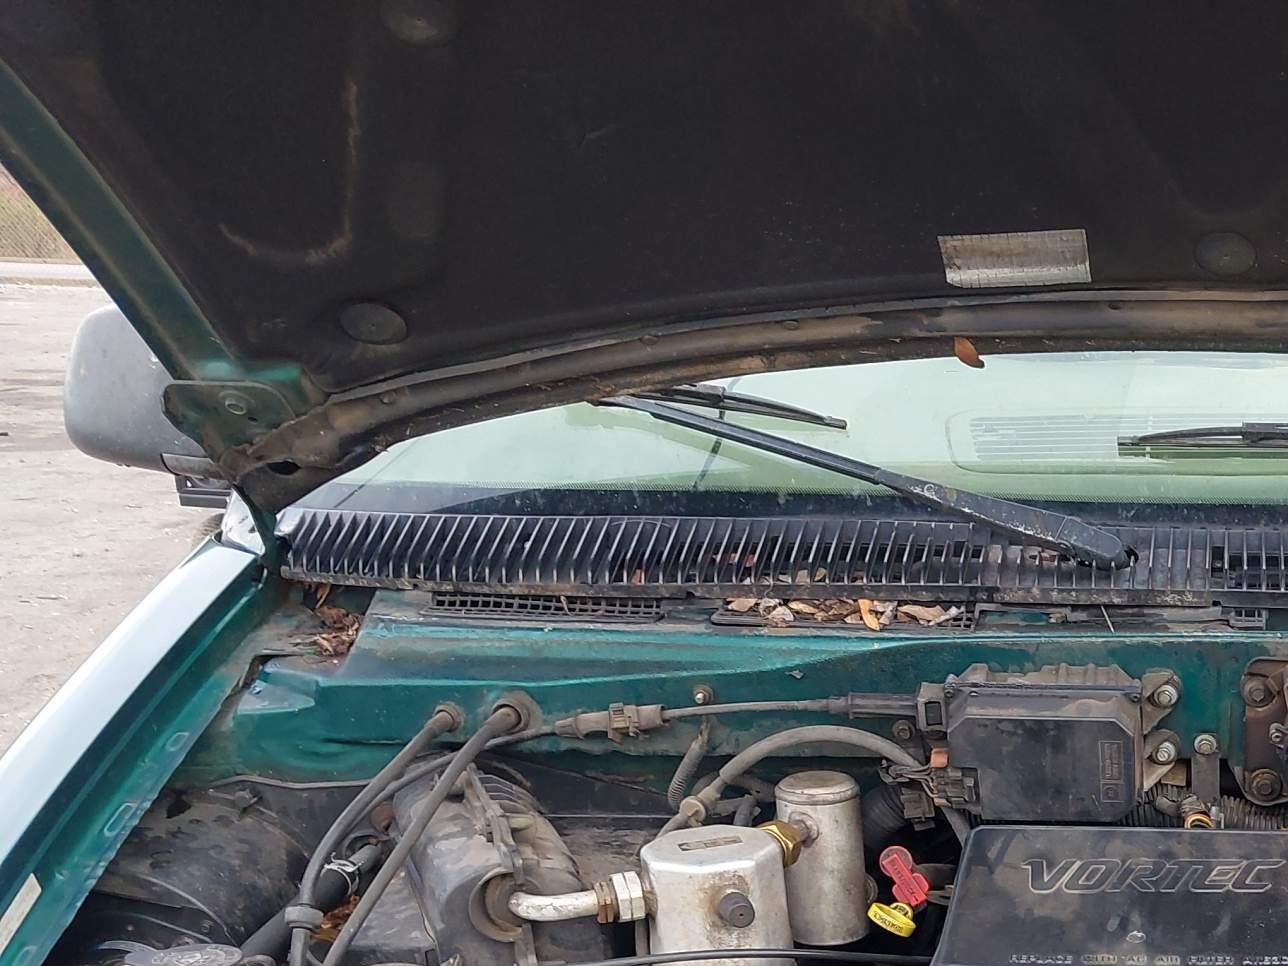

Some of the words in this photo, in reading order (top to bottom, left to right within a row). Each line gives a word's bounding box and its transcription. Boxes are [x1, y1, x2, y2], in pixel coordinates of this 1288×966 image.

[1021, 858, 1287, 893] VORTEC
[1008, 953, 1073, 965] REPLACE
[1187, 954, 1235, 966] FILTER
